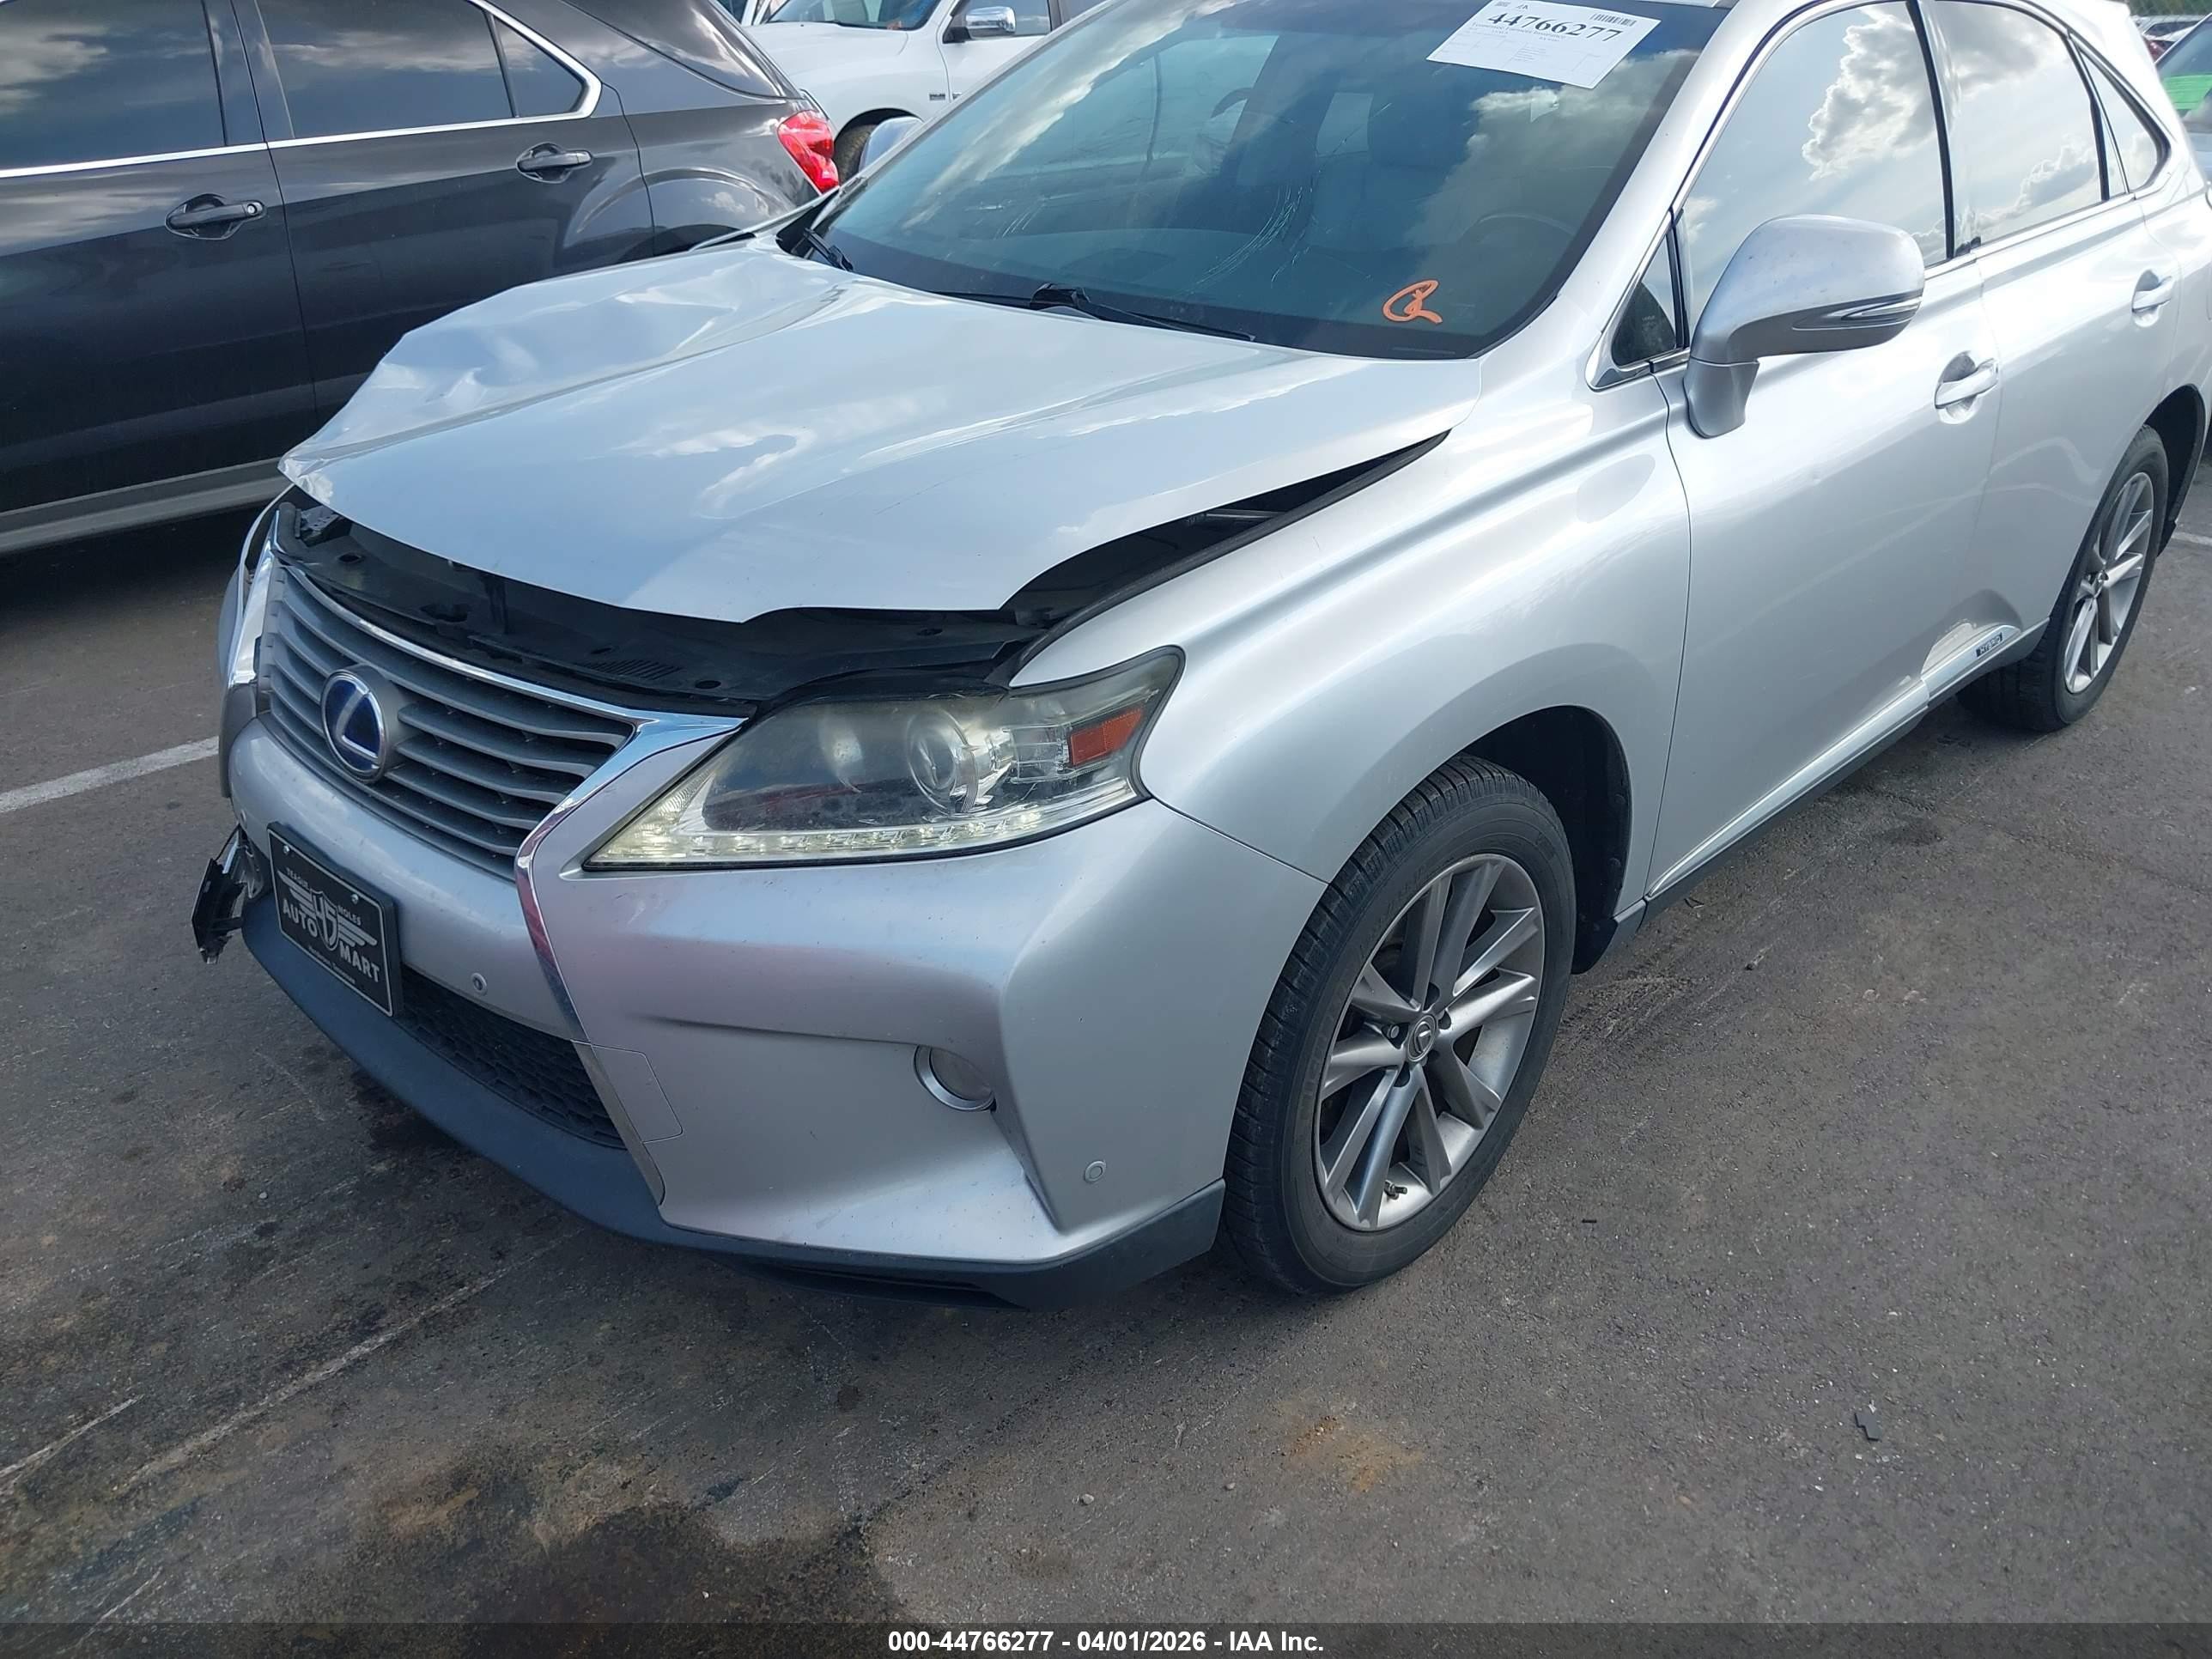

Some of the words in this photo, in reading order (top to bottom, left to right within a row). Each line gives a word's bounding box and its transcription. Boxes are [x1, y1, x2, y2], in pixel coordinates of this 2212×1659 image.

[1488, 13, 1623, 41] 44766277
[283, 899, 318, 938] AUTO
[339, 941, 380, 982] MART
